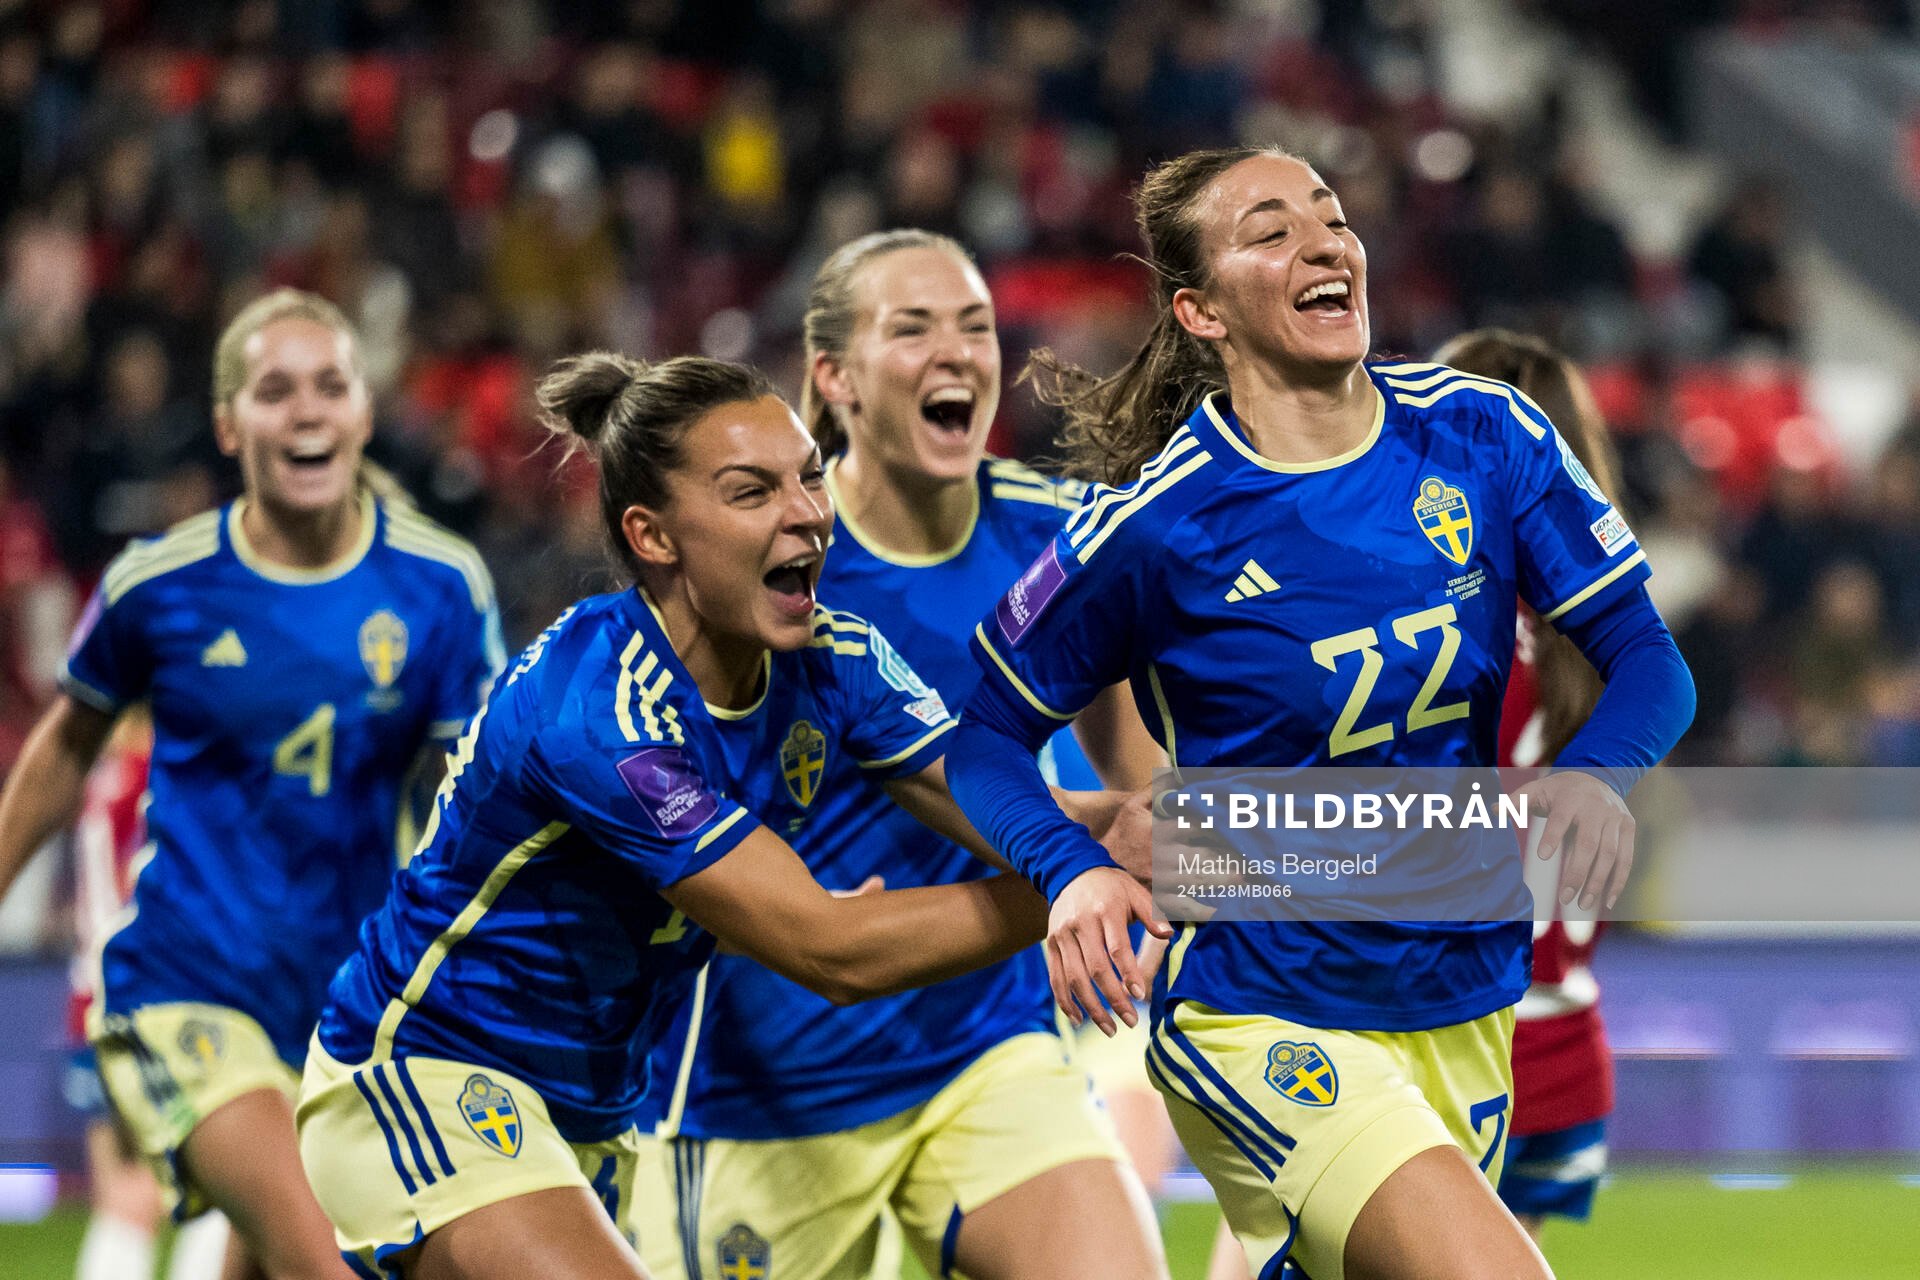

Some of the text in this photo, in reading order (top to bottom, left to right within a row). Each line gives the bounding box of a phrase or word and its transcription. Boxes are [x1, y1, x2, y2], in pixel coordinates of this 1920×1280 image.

[1422, 499, 1458, 516] SVERIGE
[1310, 603, 1470, 759] 22
[275, 702, 336, 797] 4
[1278, 1054, 1311, 1079] SVERIGE
